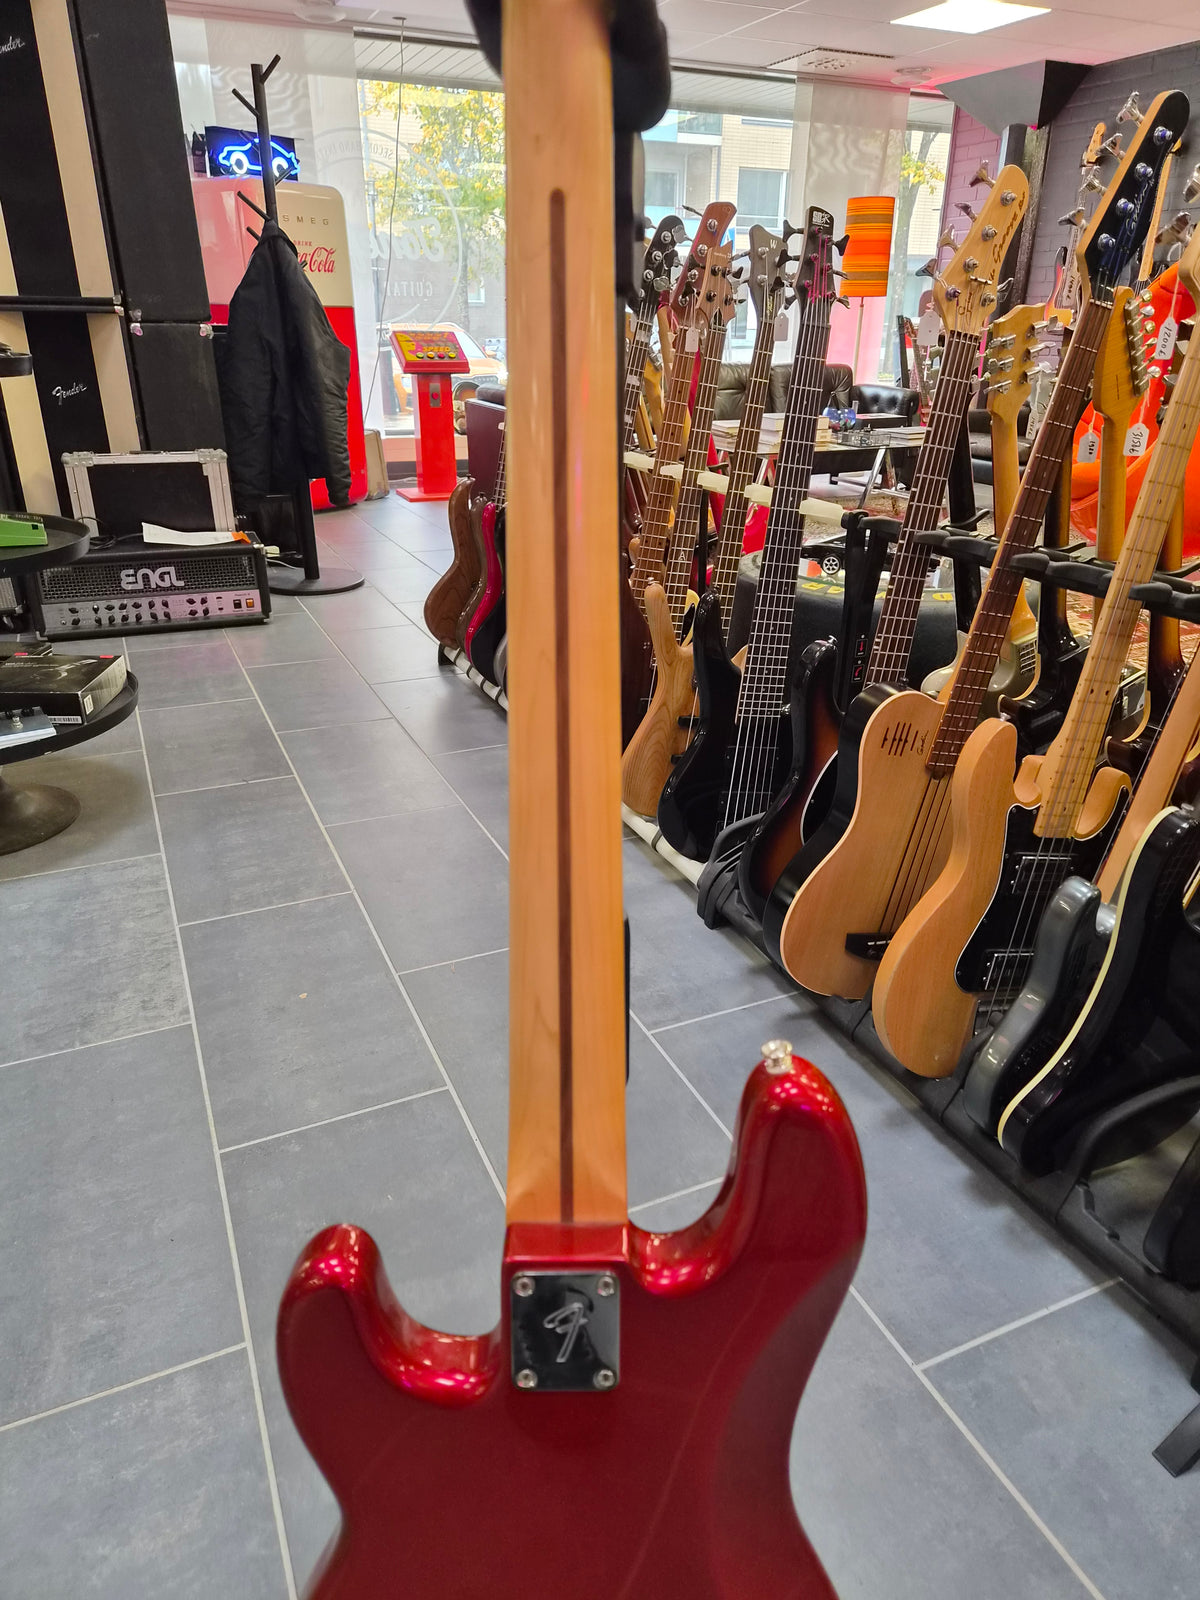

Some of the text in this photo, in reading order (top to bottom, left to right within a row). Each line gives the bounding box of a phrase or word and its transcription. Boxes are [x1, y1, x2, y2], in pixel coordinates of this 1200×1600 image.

[282, 214, 329, 226] SMEG
[52, 382, 87, 406] Fender
[120, 566, 185, 591] ENGL
